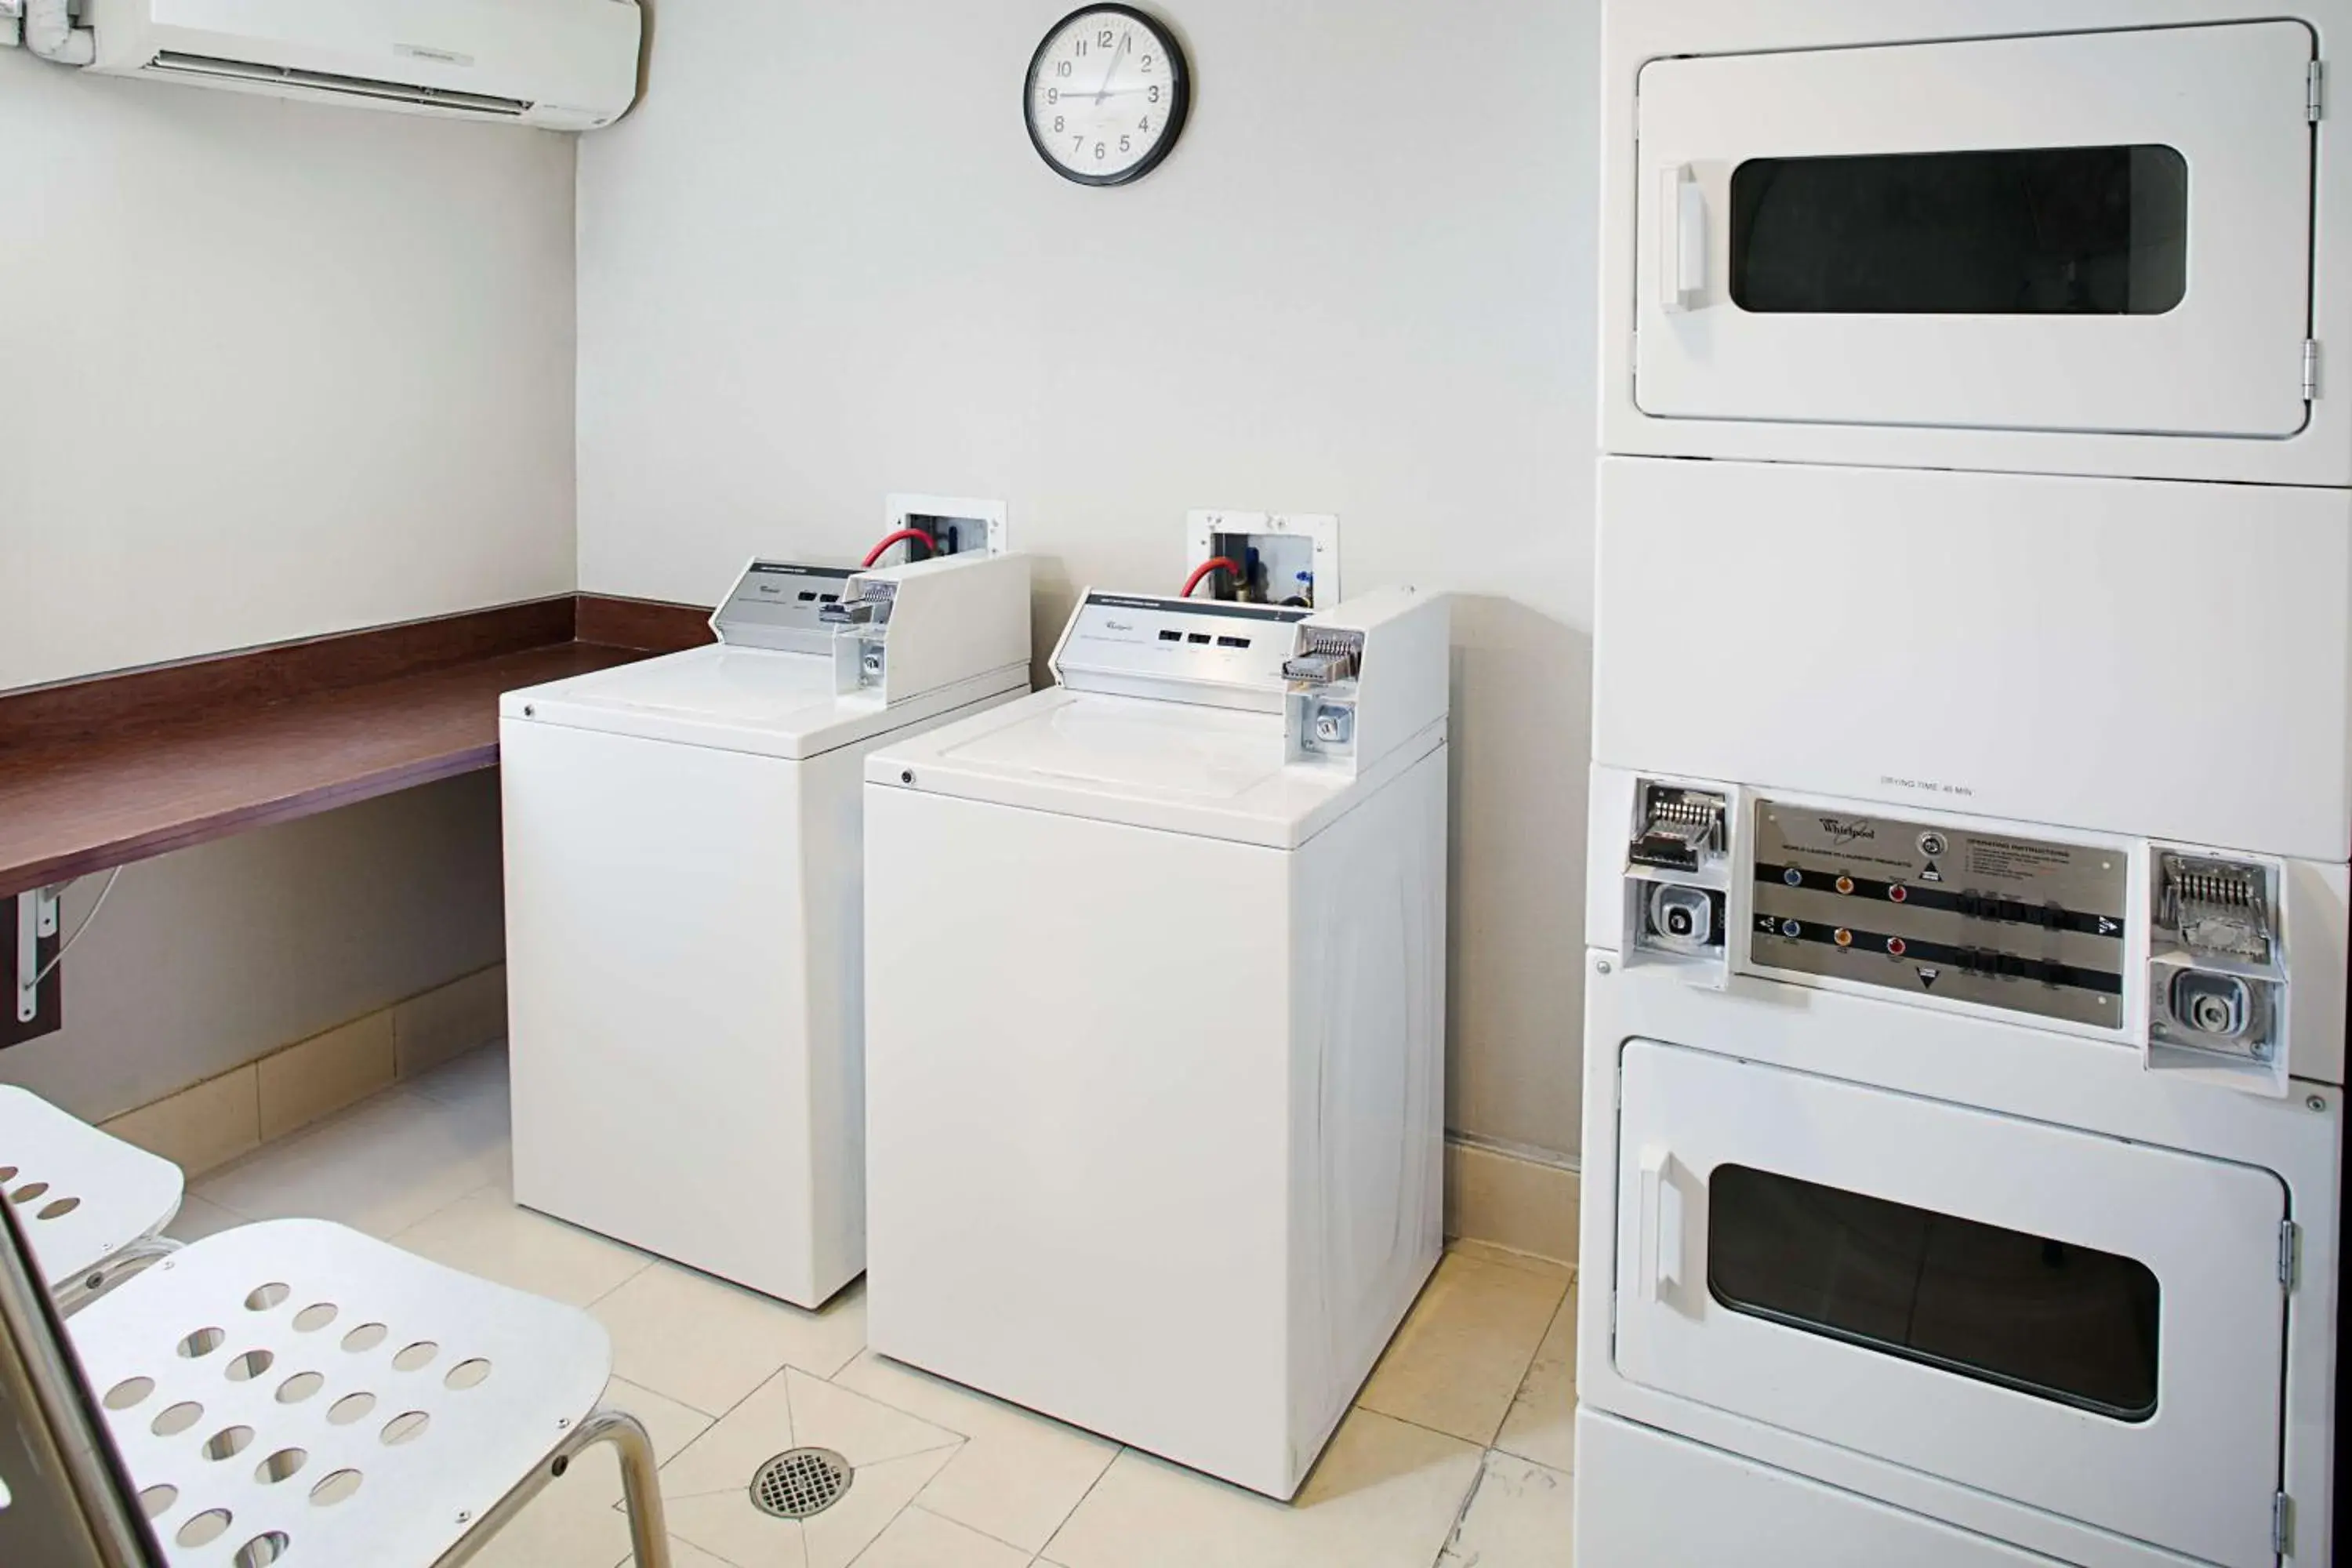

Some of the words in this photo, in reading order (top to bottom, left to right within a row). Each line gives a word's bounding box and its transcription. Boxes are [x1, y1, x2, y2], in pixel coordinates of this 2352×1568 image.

[1076, 40, 1087, 57] 11
[1098, 31, 1113, 48] 12
[1057, 60, 1073, 78] 10
[1142, 55, 1152, 73] 2
[1047, 87, 1058, 105] 9
[1148, 85, 1160, 103] 3
[1054, 115, 1065, 132] 8
[1138, 115, 1149, 133] 4
[1073, 136, 1083, 152] 7
[1095, 142, 1105, 160] 6
[1119, 135, 1130, 152] 5
[1819, 818, 1875, 840] Whirlpool
